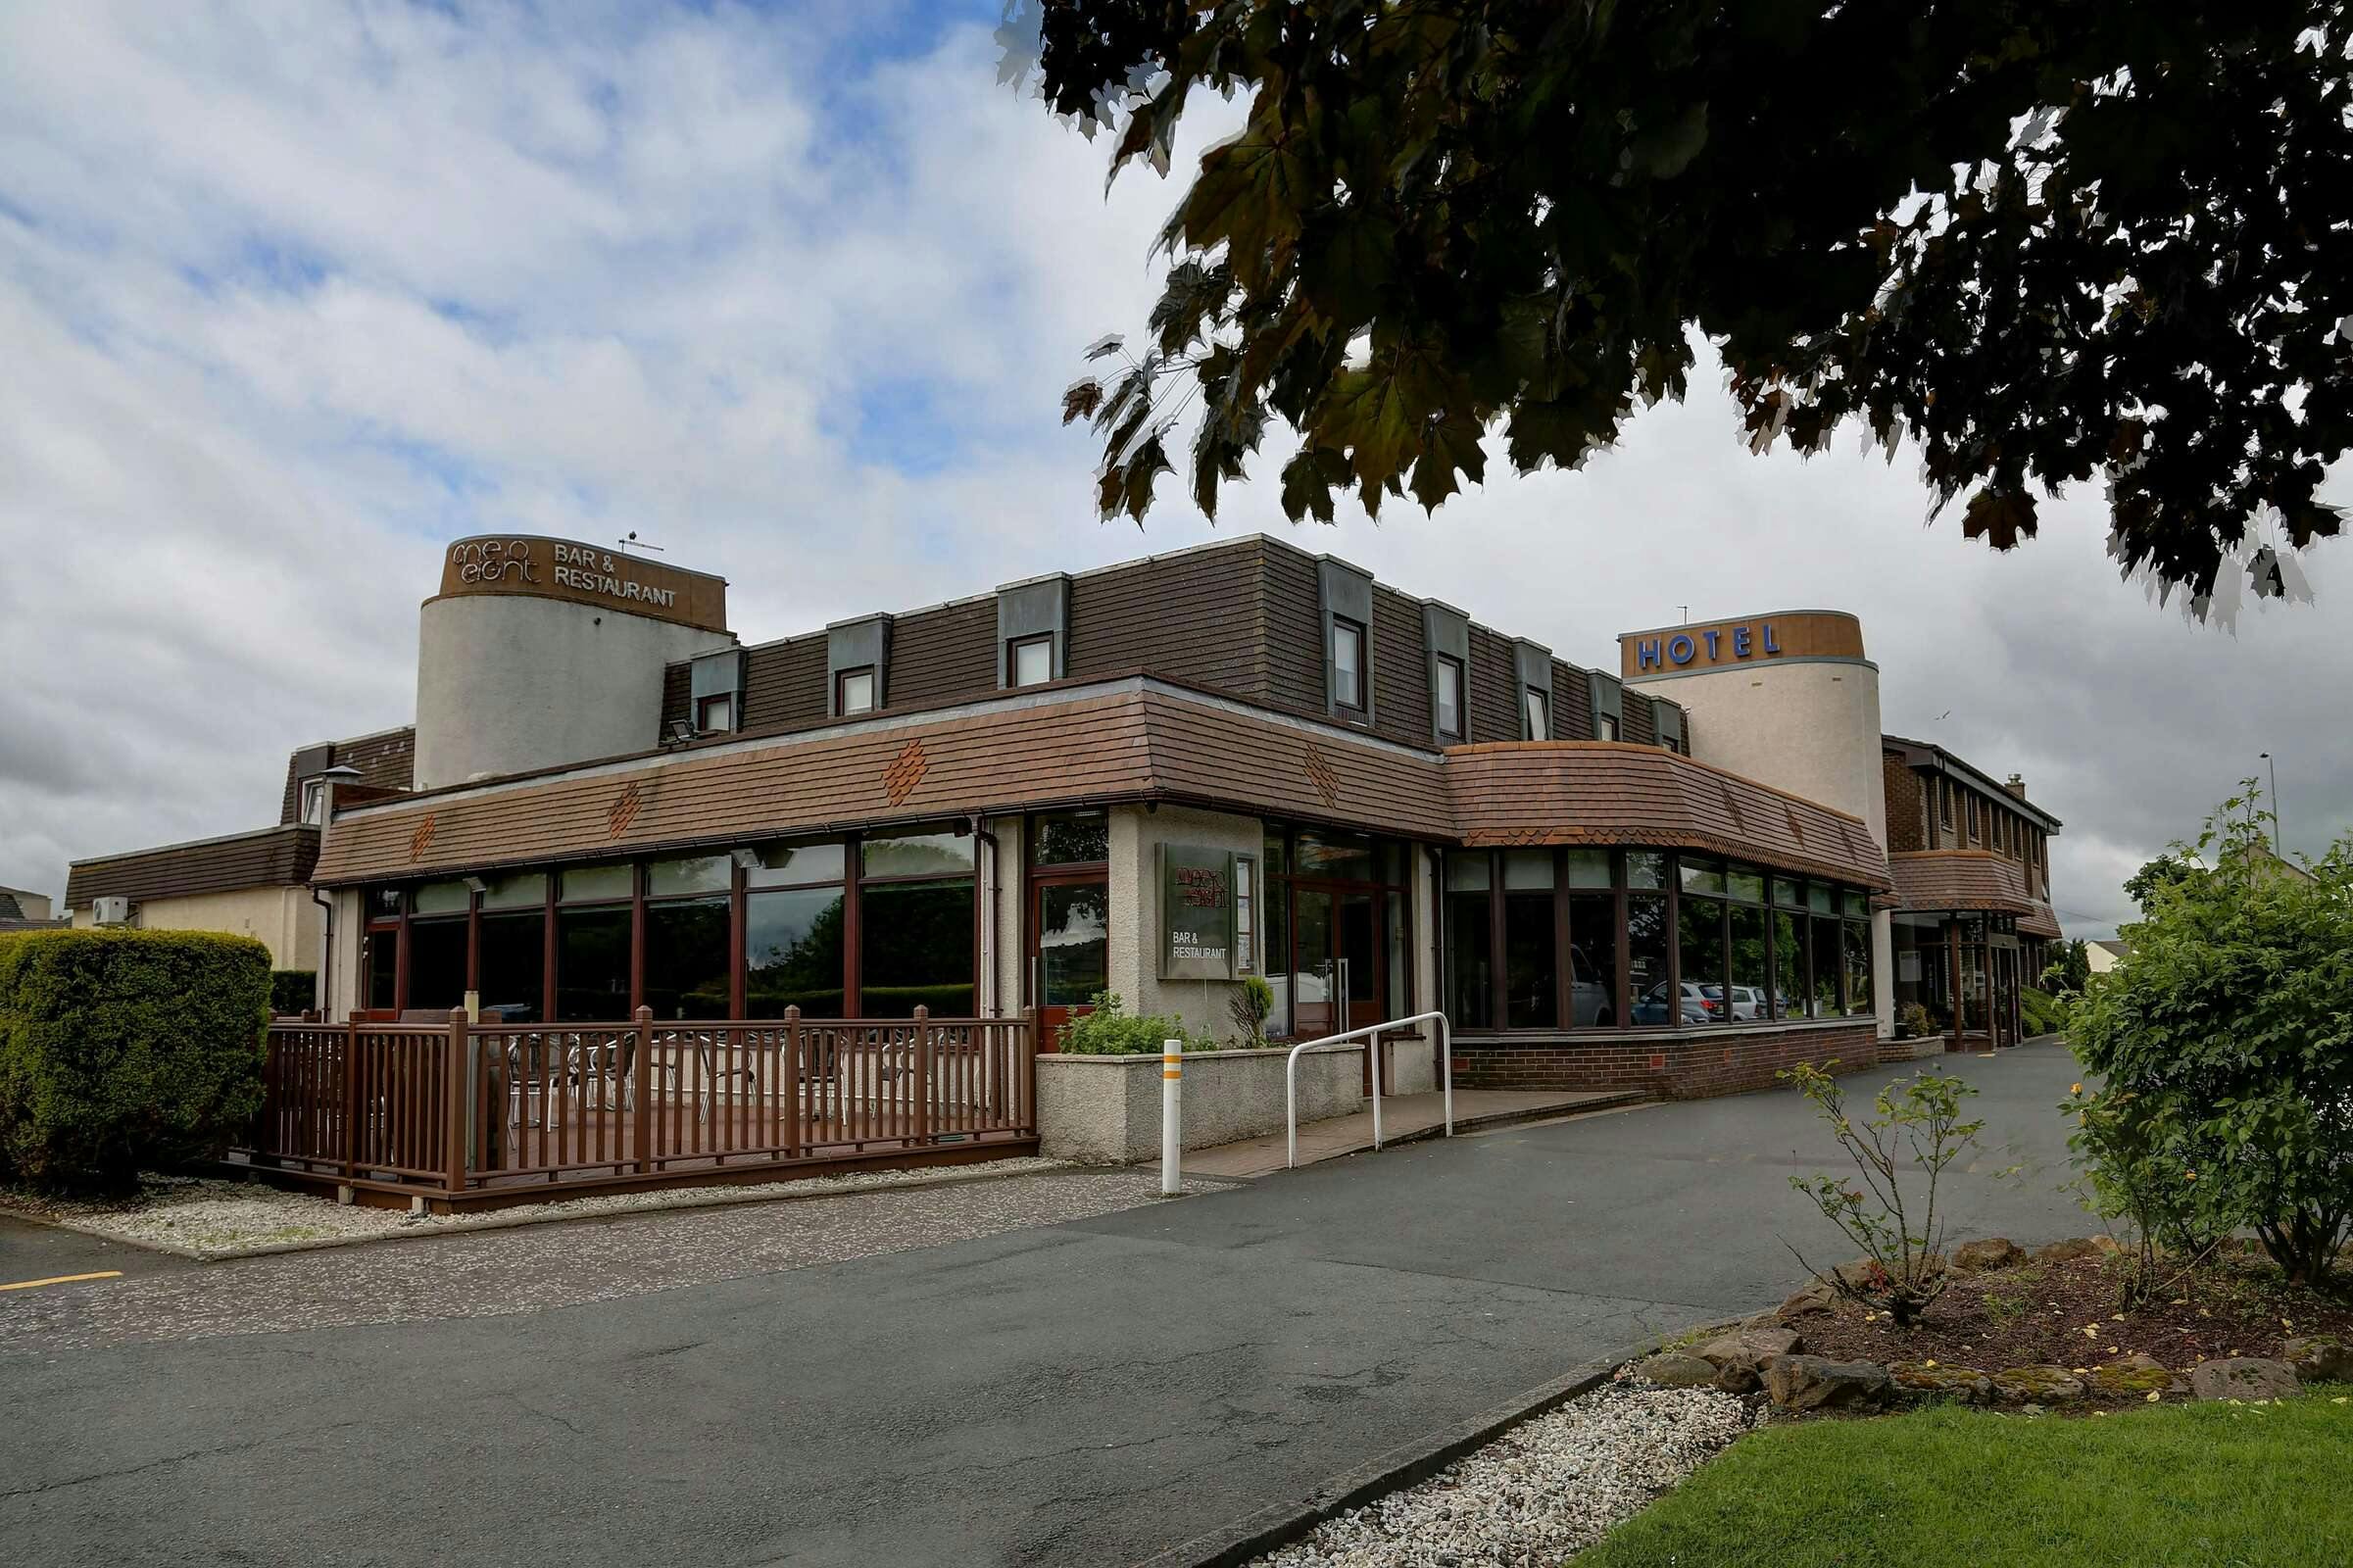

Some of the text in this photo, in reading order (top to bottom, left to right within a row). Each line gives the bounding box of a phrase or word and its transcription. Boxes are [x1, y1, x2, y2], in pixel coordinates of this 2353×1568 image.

[555, 544, 614, 573] BAR &
[555, 565, 676, 608] RESTAURANT
[1638, 624, 1781, 668] HOTEL
[1173, 932, 1199, 945] BAR &
[1173, 947, 1227, 959] RESTAURANT
